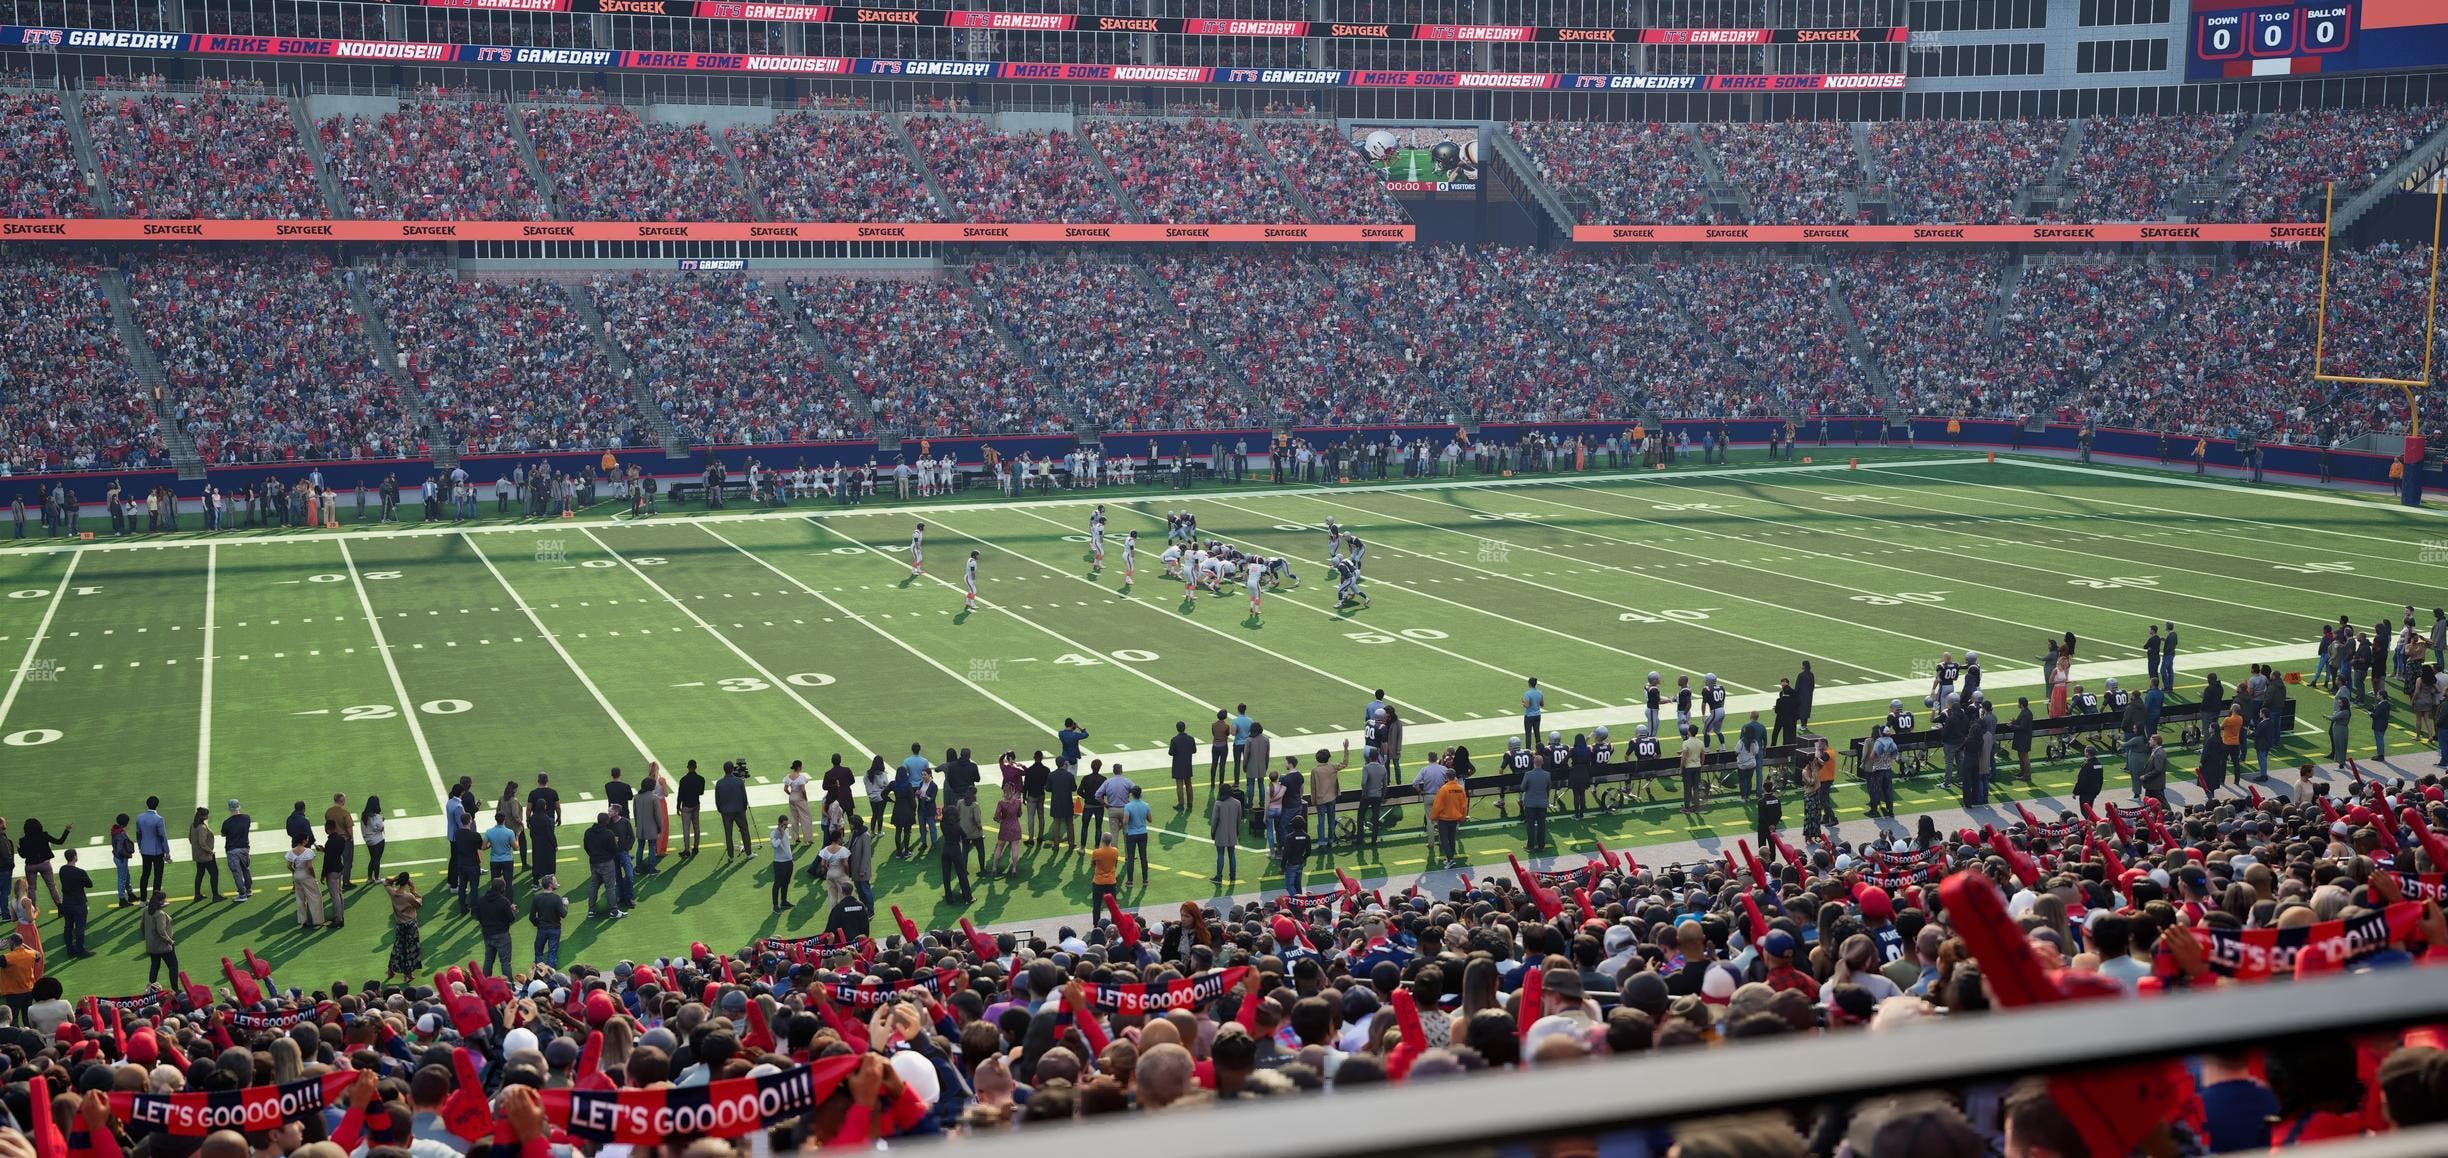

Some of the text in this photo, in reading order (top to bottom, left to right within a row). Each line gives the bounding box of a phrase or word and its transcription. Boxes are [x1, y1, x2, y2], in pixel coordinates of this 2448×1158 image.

[600, 0, 665, 15] SEATGEEK
[714, 4, 817, 20] IT'S GAMEDAY!
[2307, 8, 2346, 19] BALL ON
[857, 9, 918, 24] SEATGEEK
[965, 13, 1062, 28] IT'S GAMEDAY!
[2207, 16, 2238, 26] DOWN
[2259, 12, 2290, 22] TO GO
[1100, 17, 1158, 32] SEATGEEK
[1201, 20, 1295, 35] IT'S GAMEDAY!
[1331, 24, 1388, 37] SEATGEEK
[1431, 26, 1523, 40] IT'S GAMEDAY!
[1559, 28, 1615, 42] SEATGEEK
[1662, 30, 1759, 43] IT'S GAMEDAY!
[1797, 28, 1860, 42] SEATGEEK
[2264, 25, 2282, 47] 0
[2316, 21, 2335, 43] 0
[22, 29, 179, 50] IT'S GAMEDAY!
[2213, 29, 2231, 50] 0
[210, 37, 442, 60] MAKE SOME NOOOOISE!!!
[477, 48, 610, 65] IT'S GAMEDAY!
[637, 53, 840, 72] MAKE SOME NOOOOISE!!!
[871, 60, 990, 76] IT'S GAMEDAY!
[1014, 65, 1201, 81] MAKE SOME NOOOOISE!!!
[1228, 69, 1340, 84] IT'S GAMEDAY!
[1363, 73, 1546, 87] MAKE SOME NOOOOISE!!!
[1575, 76, 1695, 89] IT'S GAMEDAY!
[1719, 75, 1905, 89] MAKE SOME NOOOOISE
[1386, 182, 1420, 191] 00:00
[3, 224, 65, 234] SEATGEEK
[144, 224, 202, 235] SEATGEEK
[277, 225, 332, 235] SEATGEEK
[403, 225, 456, 235] SEATGEEK
[524, 226, 574, 235] SEATGEEK
[639, 226, 688, 236] SEATGEEK
[751, 227, 798, 236] SEATGEEK
[859, 227, 904, 236] SEATGEEK
[964, 228, 1008, 237] SEATGEEK
[1066, 228, 1109, 237] SEATGEEK
[1167, 229, 1208, 237] SEATGEEK
[1265, 229, 1307, 237] SEATGEEK
[1362, 229, 1403, 237] SEATGEEK
[1913, 229, 1963, 238] SEATGEEK
[2034, 228, 2094, 237] SEATGEEK
[2141, 228, 2199, 237] SEATGEEK
[2270, 227, 2326, 237] SEATGEEK
[699, 260, 744, 270] GAMEDAY!
[1945, 668, 1957, 680] 00
[1713, 690, 1724, 702] 00
[2083, 695, 2097, 706] 00
[2116, 693, 2127, 706] 00
[1899, 716, 1912, 729] 00
[1639, 742, 1655, 756] 00
[1515, 755, 1530, 769] 00
[1597, 750, 1611, 764] 00
[1883, 853, 1899, 864] LET'S
[1863, 869, 1928, 888] LET'S GOOOOO!!!
[2400, 876, 2436, 900] LET'S
[768, 940, 785, 950] LET'S
[2211, 934, 2266, 972] LET'S
[837, 986, 869, 1004] LET'S
[1097, 975, 1223, 1010] LET'S GOOOOO!!!
[116, 994, 157, 1008] GOOOOO!!!
[234, 1008, 317, 1027] LET'S GOOOOO!!!
[132, 1083, 322, 1126] LET'S GOOOOO!!!
[571, 1072, 813, 1134] LET'S GOOOOO!!!
